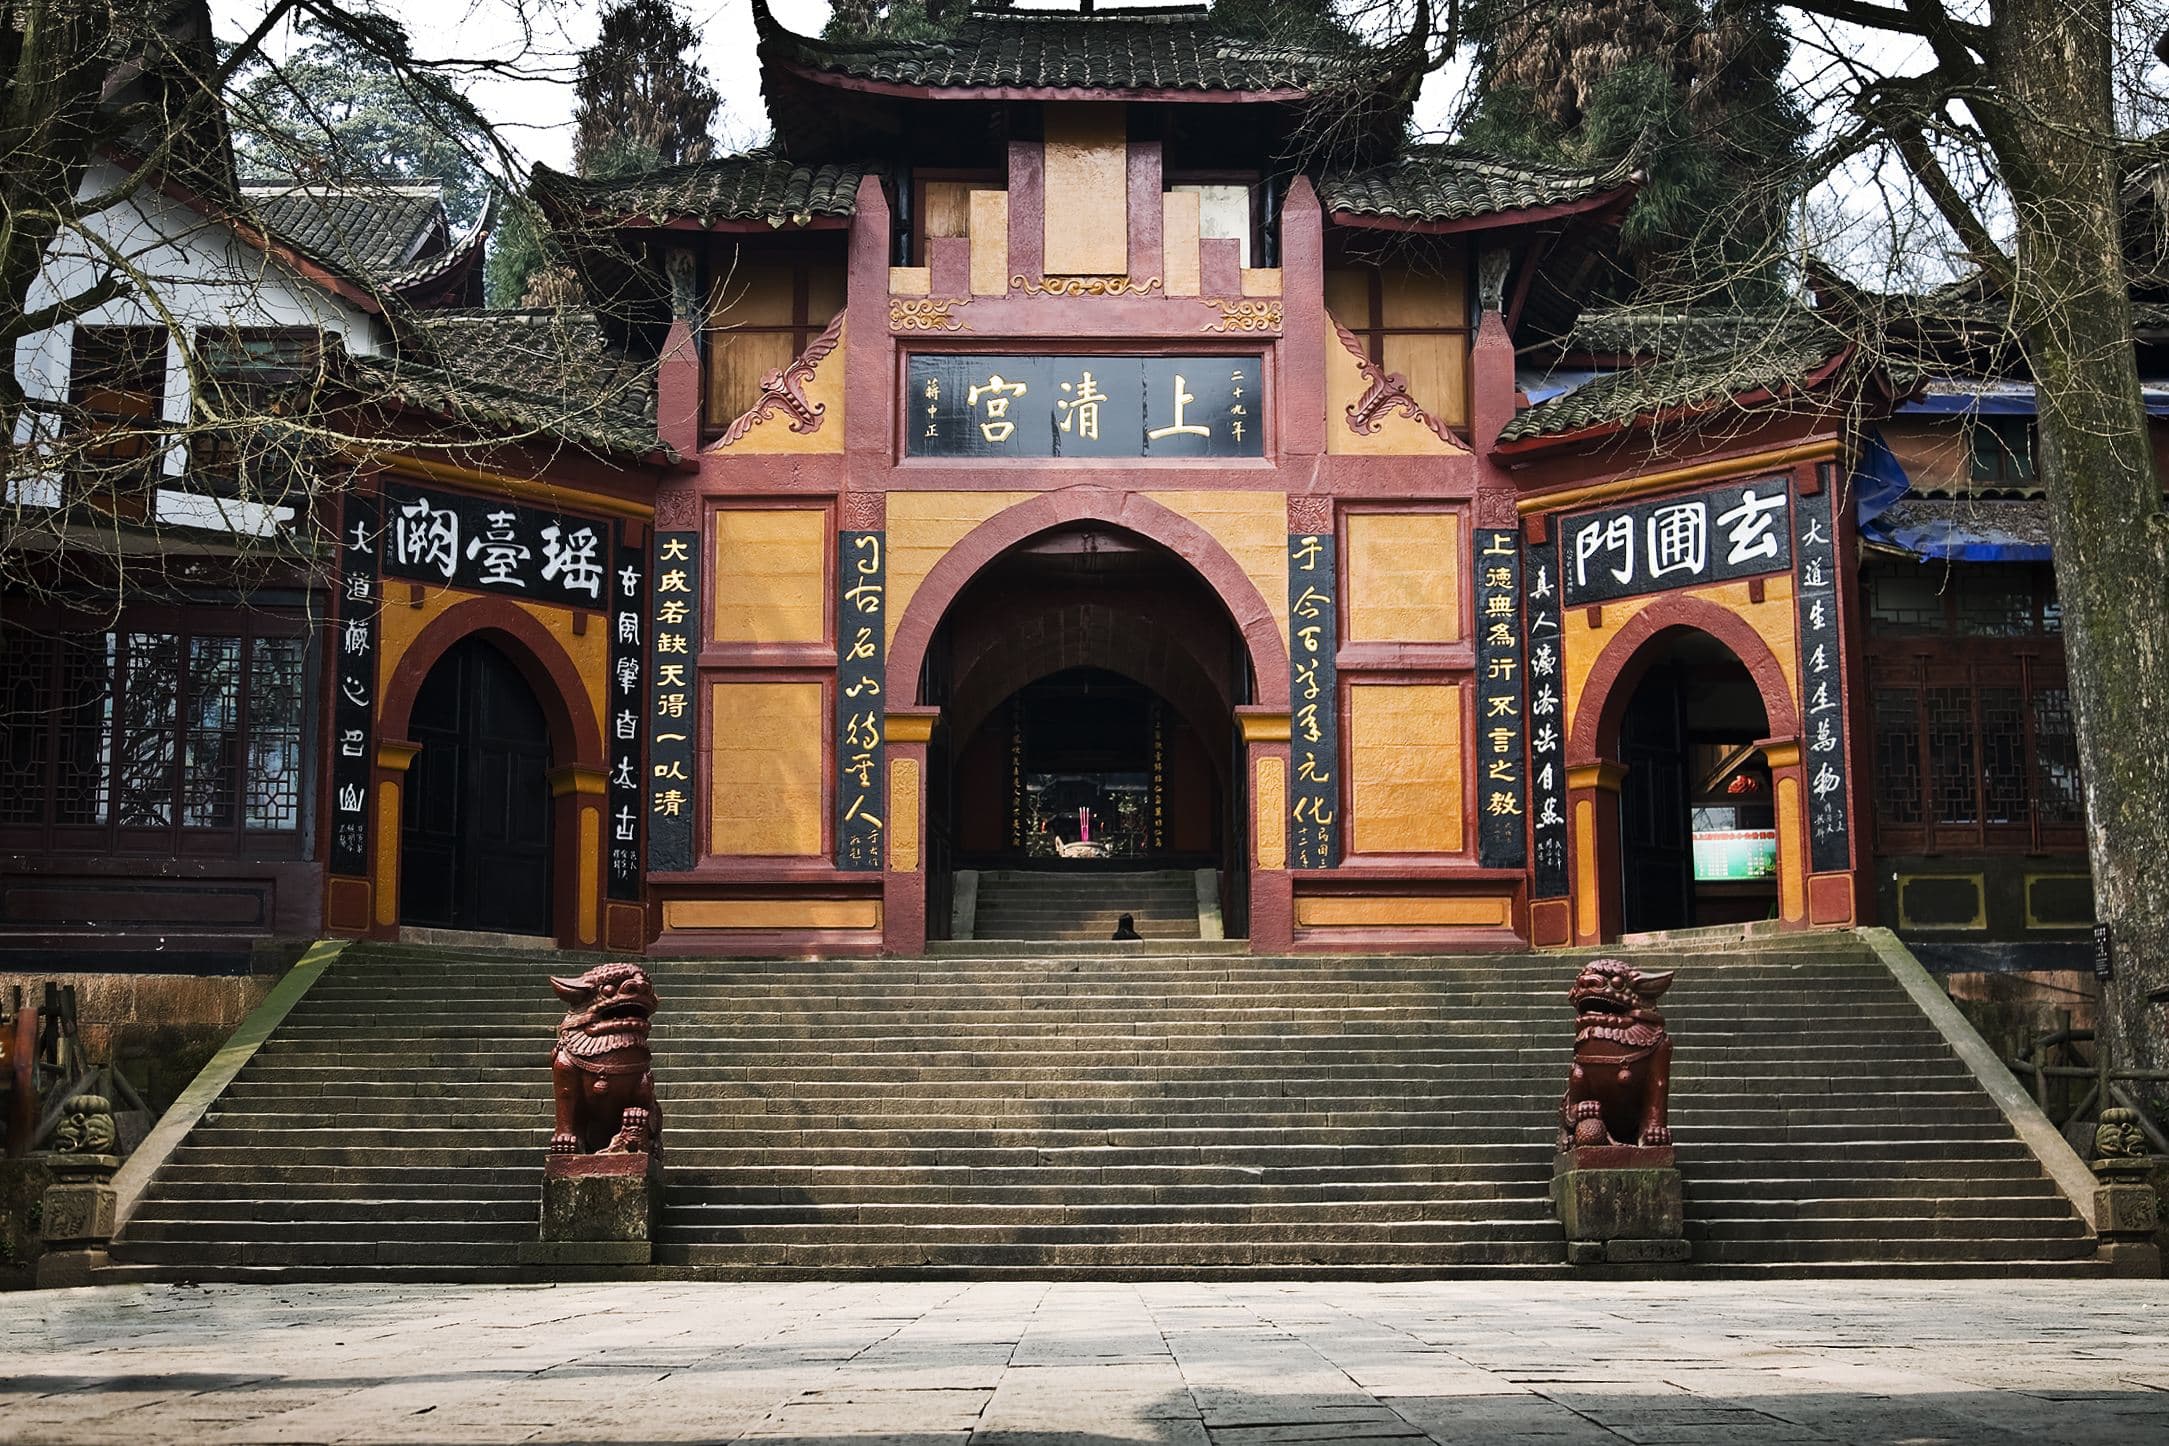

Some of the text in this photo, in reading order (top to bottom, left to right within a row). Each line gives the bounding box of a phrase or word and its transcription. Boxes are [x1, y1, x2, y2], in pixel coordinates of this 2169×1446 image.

[924, 378, 940, 438] 蔣中正
[967, 371, 1210, 442] 上清宮
[1230, 370, 1246, 442] 二十九年
